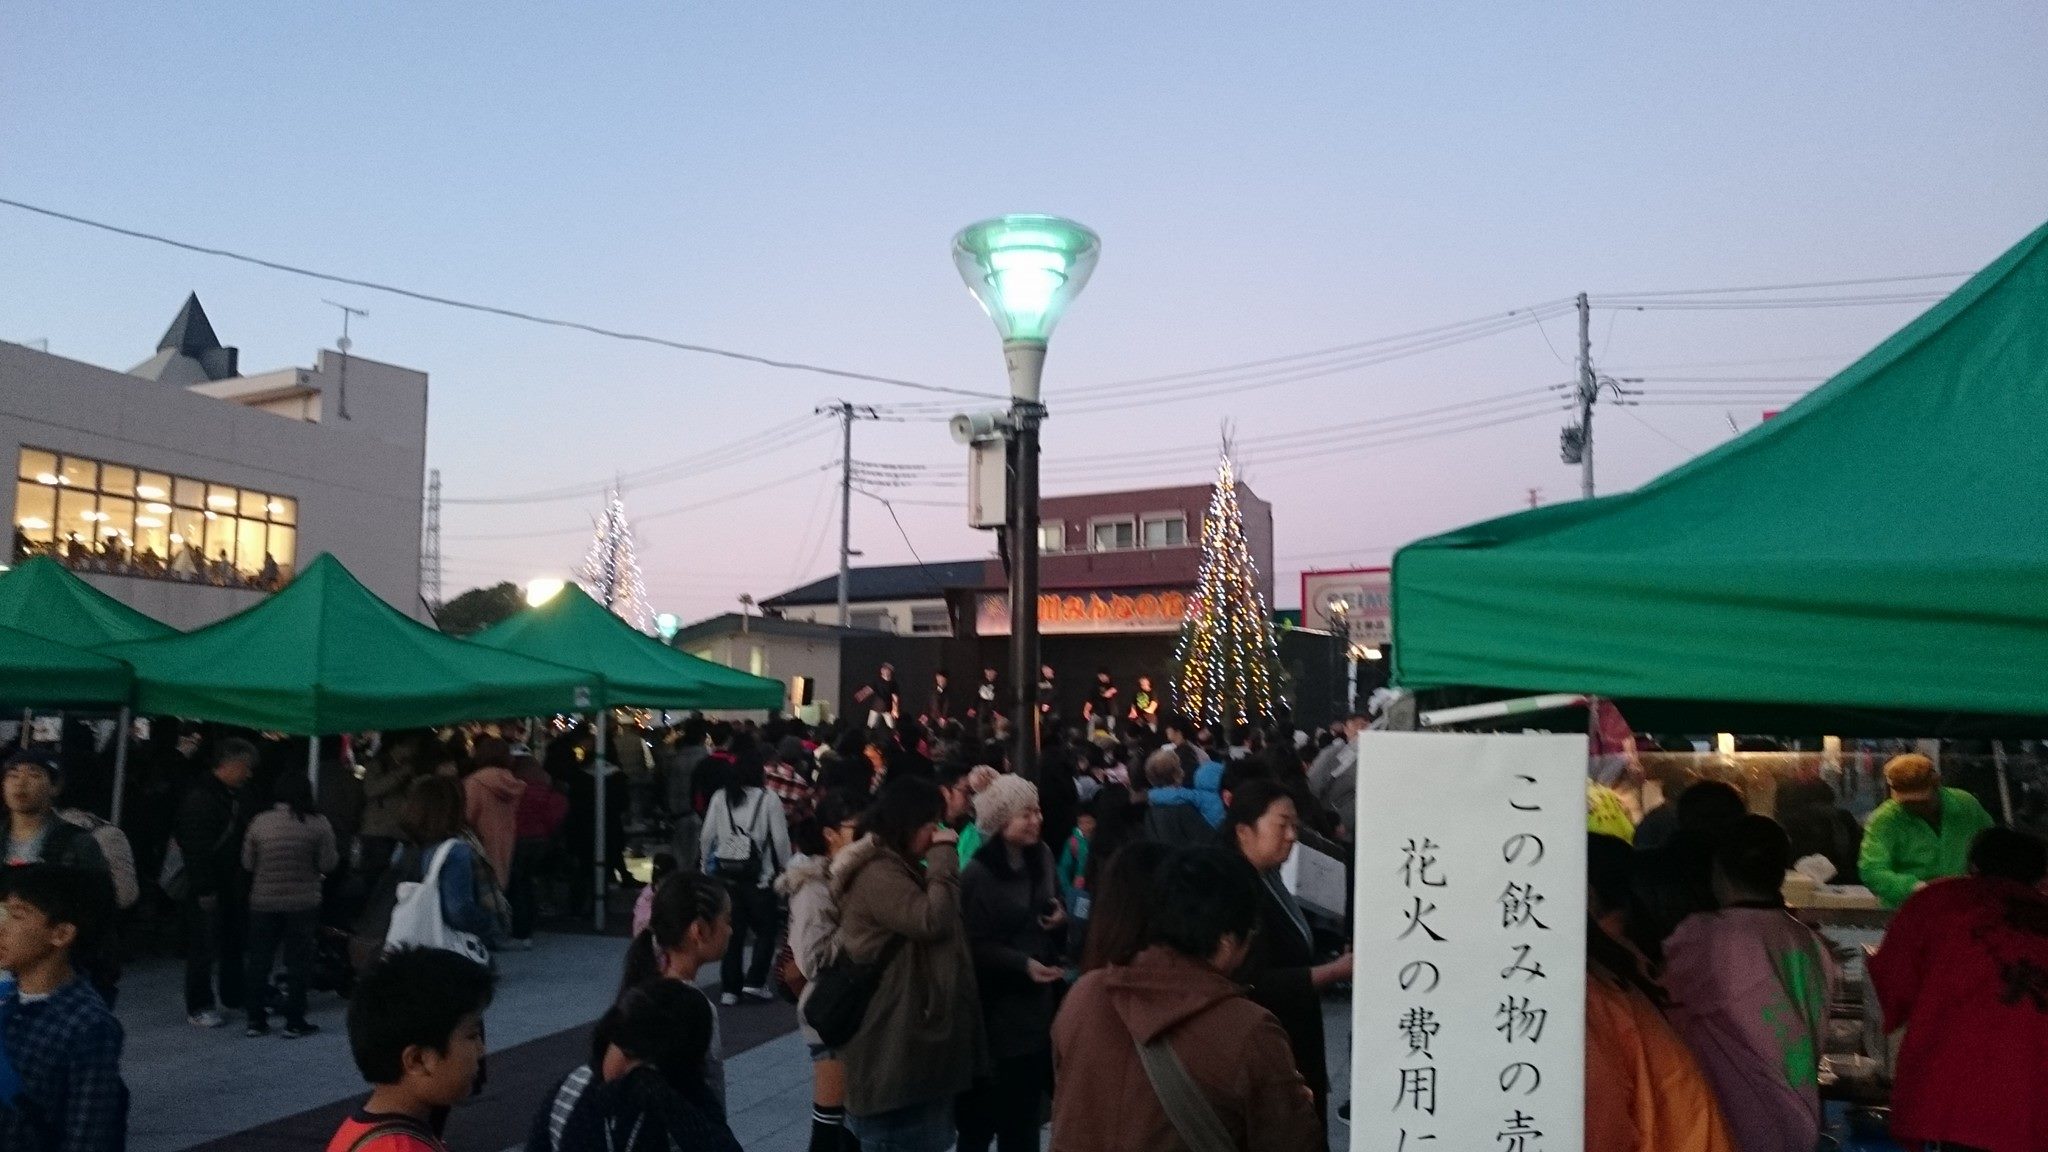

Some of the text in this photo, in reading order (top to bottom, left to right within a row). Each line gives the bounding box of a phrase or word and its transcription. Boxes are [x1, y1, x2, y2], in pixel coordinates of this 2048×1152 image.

[1391, 837, 1449, 1152] 花火の費用に
[1494, 773, 1551, 1152] この飲み物の売
